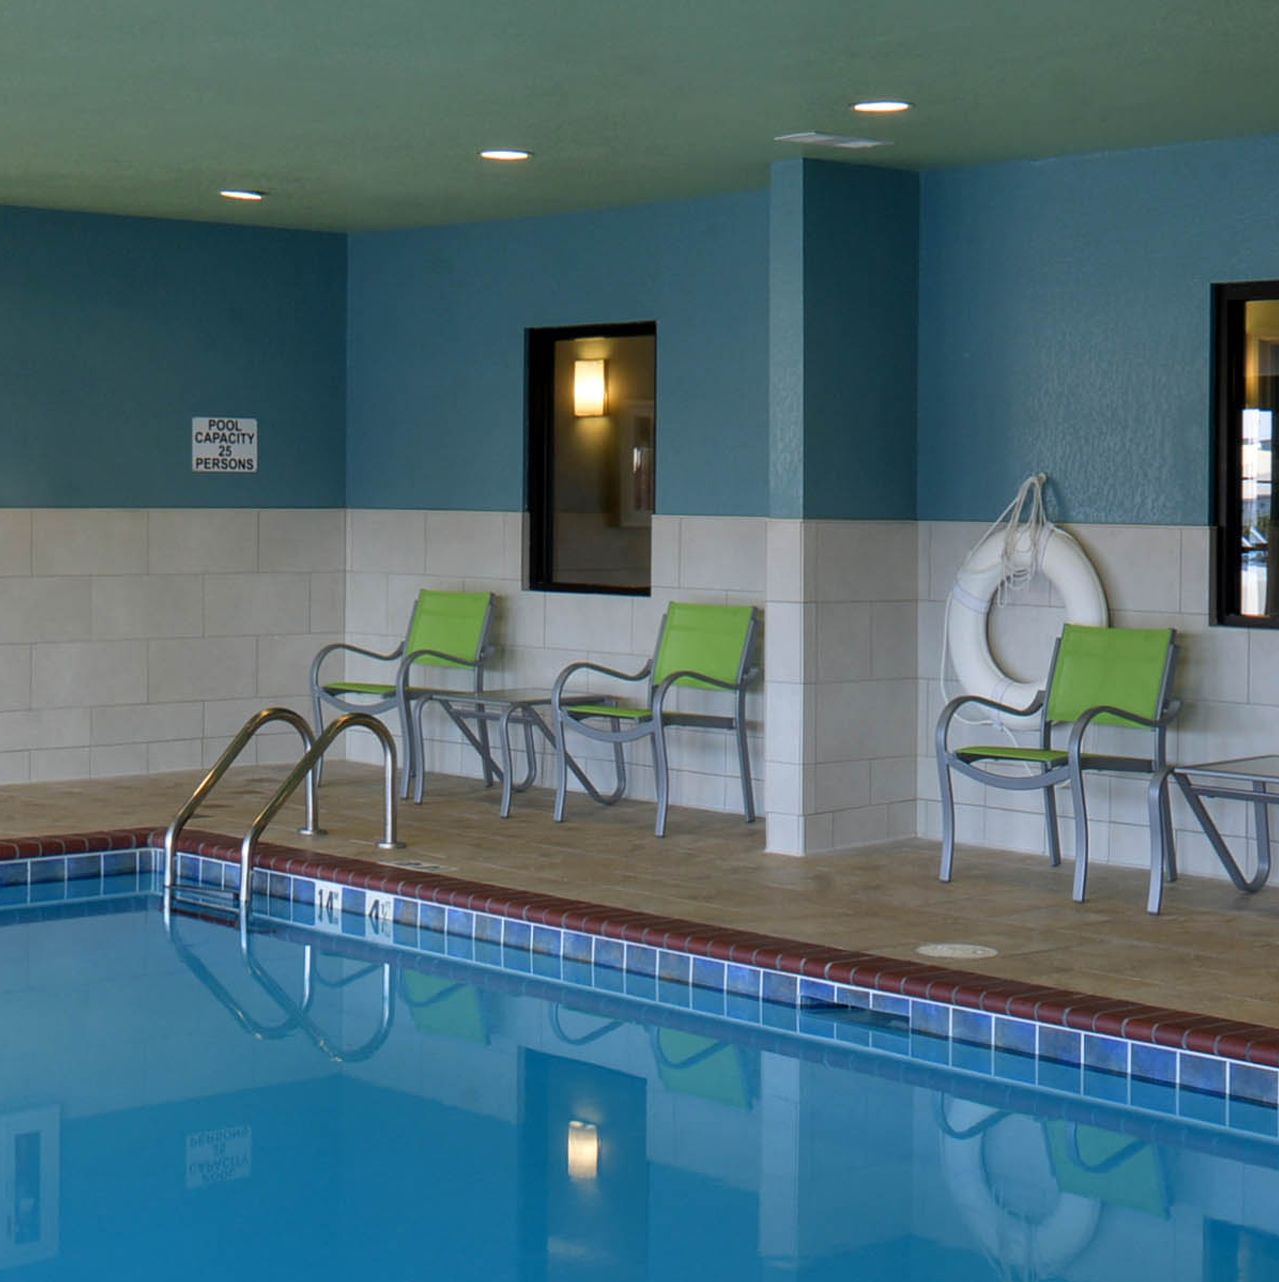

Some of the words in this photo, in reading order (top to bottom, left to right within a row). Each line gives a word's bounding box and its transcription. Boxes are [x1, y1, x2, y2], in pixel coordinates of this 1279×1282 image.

[208, 419, 242, 432] POOL
[194, 431, 255, 444] CAPACITY
[218, 445, 232, 457] 25
[195, 457, 254, 471] PERSONS
